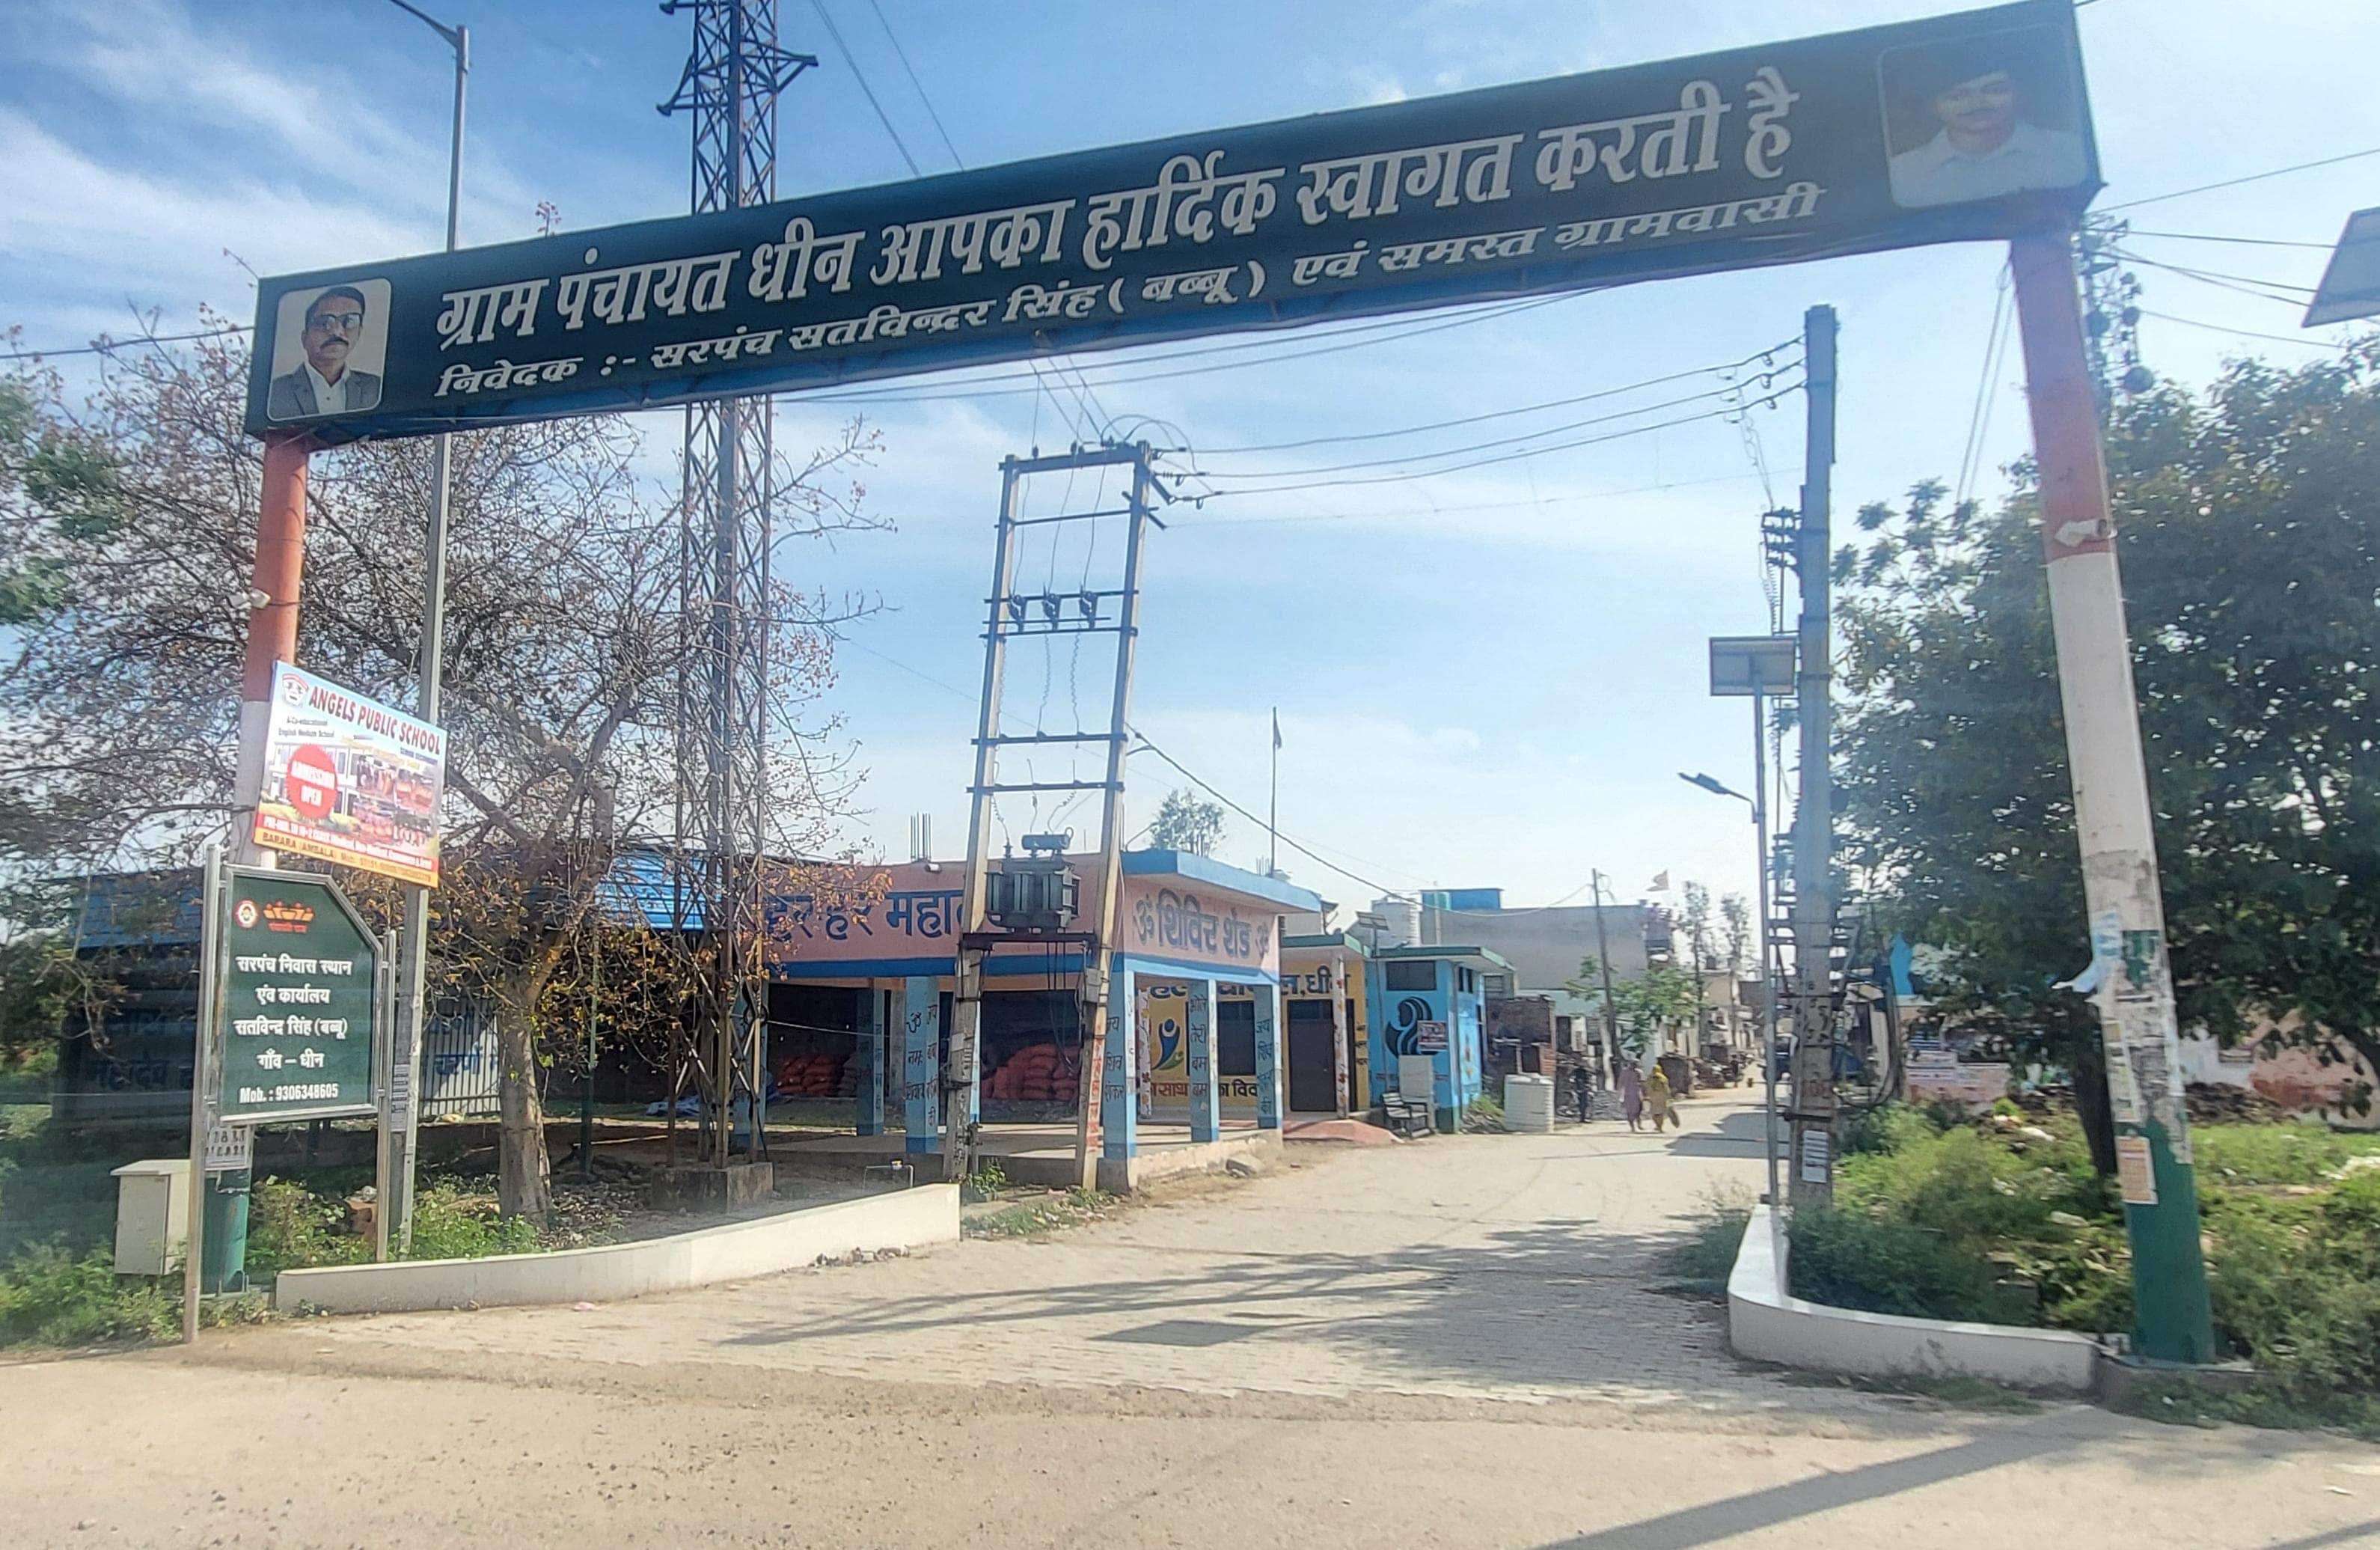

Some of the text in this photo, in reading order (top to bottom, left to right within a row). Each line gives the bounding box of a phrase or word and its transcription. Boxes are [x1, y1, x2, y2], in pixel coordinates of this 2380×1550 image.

[435, 66, 1800, 352] ग्राम पंचायत धीन आपका हार्दिक स्वागत करती है
[434, 357, 584, 397] निवेदक
[650, 326, 783, 371] सरपंच
[1292, 239, 1370, 286] एवं
[1377, 226, 1547, 273] समस्त
[1553, 181, 1829, 251] ग्रामवासी
[309, 686, 441, 755] ANGELS PUBLIC SCHOOL
[236, 952, 352, 975] सरपंच निवास स्थान
[278, 983, 331, 1004] कार्यालय
[287, 1014, 313, 1036] सिंह
[257, 1048, 283, 1070] गाँव
[299, 1048, 325, 1069] धीन
[275, 1084, 339, 1102] 9306348605
